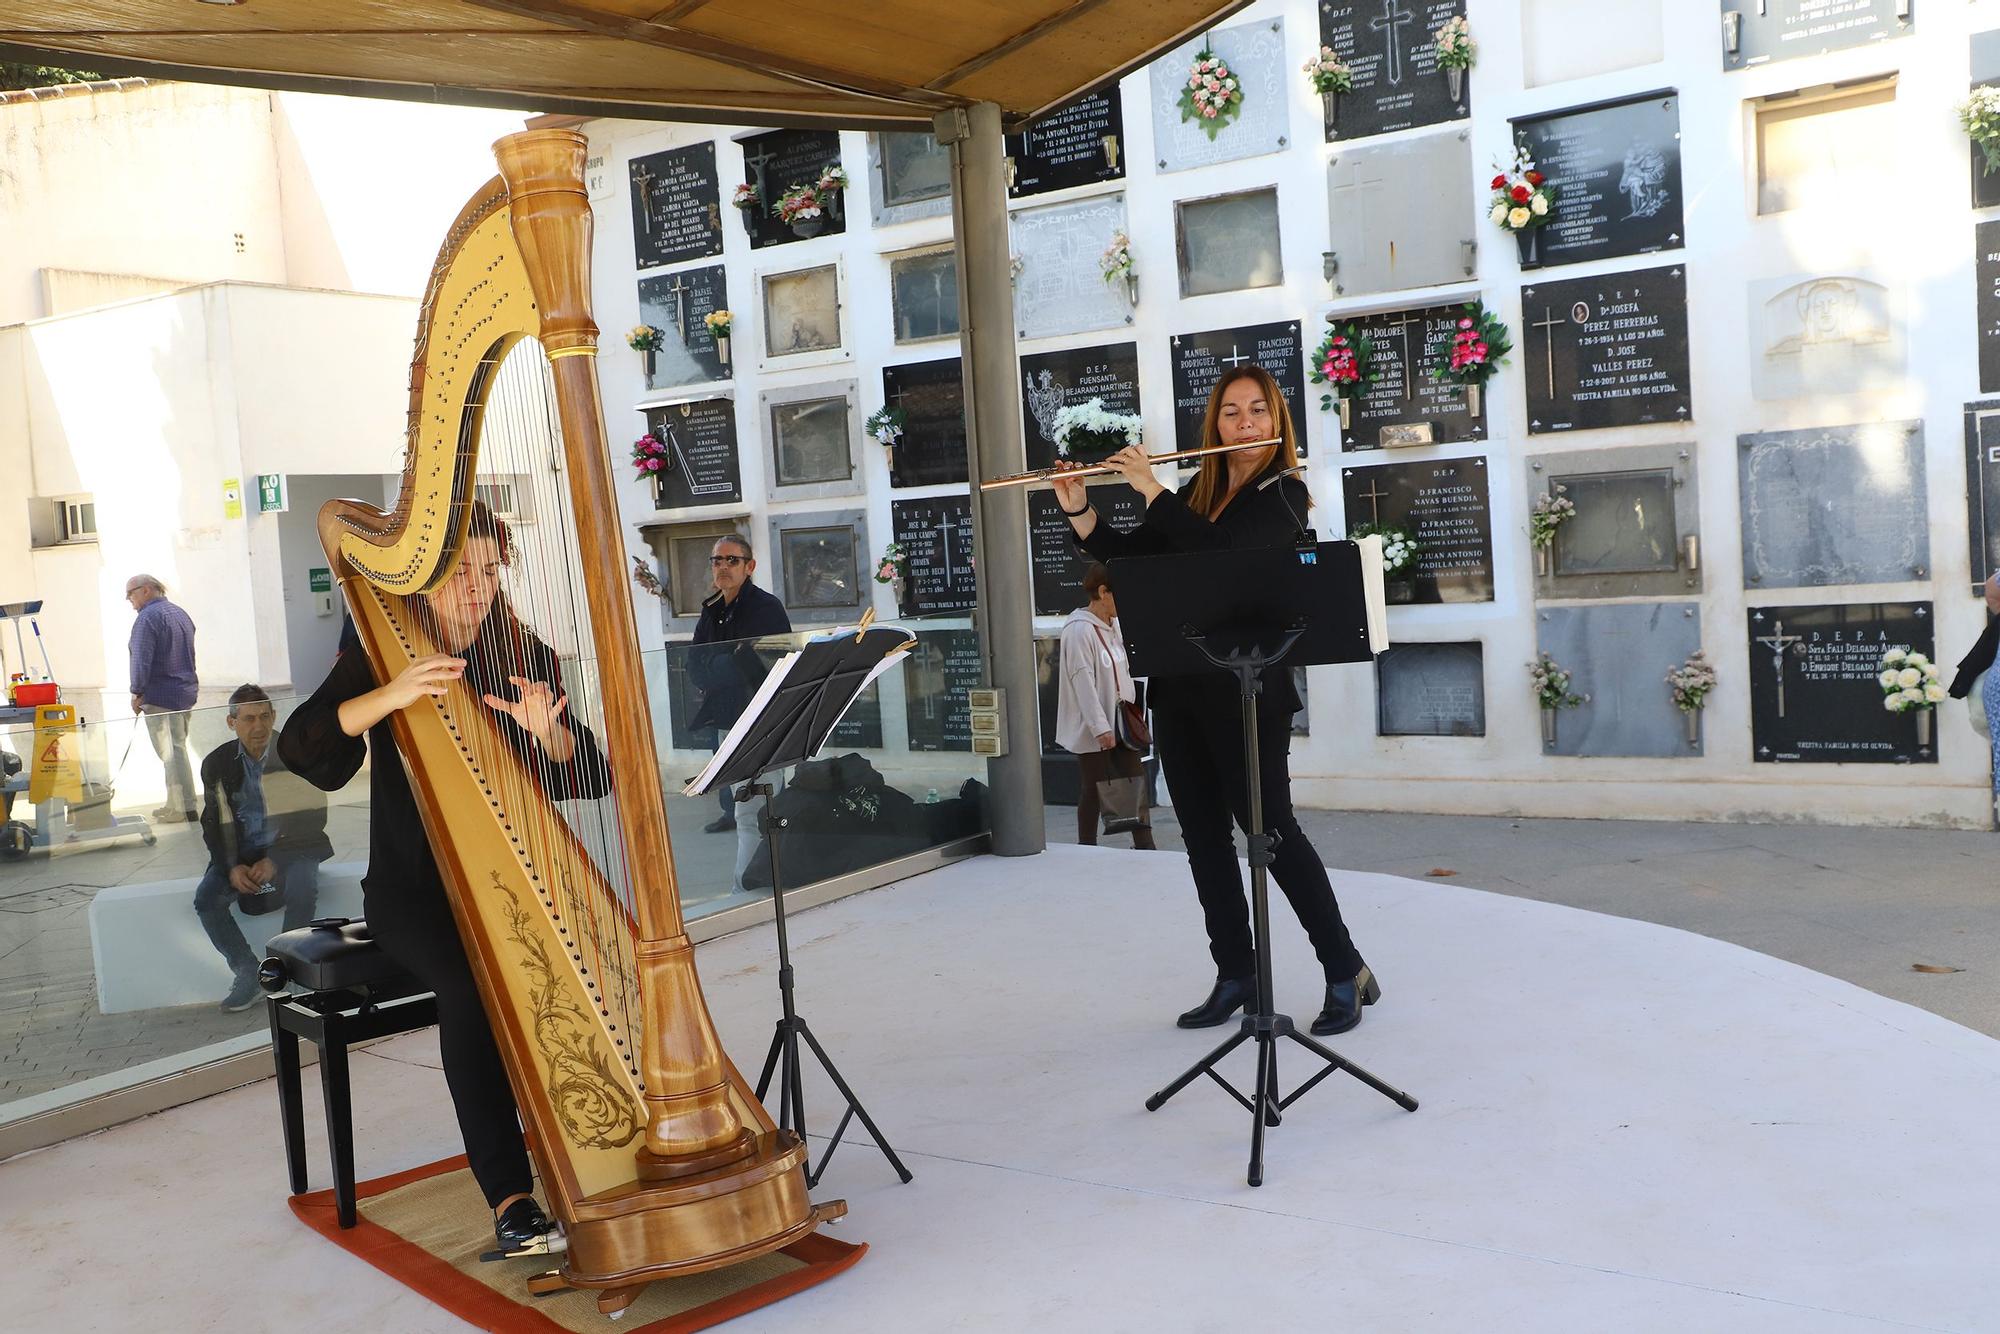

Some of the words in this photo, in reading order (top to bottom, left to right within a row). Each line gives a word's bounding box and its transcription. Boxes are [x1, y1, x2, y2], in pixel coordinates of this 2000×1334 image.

[1436, 2, 1456, 12] EMILIA
[1432, 11, 1452, 20] BAENA
[1335, 33, 1354, 41] BAENA
[1418, 60, 1434, 68] BAENA
[1070, 124, 1087, 134] PEREZ
[1089, 119, 1109, 130] RIVERA
[1575, 171, 1608, 181] CARRETERO
[674, 192, 691, 201] RAFAEL
[662, 203, 681, 213] ZAMORA
[1559, 204, 1592, 214] CARRETERO
[662, 230, 680, 239] ZAMORA
[1560, 227, 1593, 236] CARRETERO
[1610, 303, 1639, 314] JOSEFA
[1437, 320, 1456, 330] JUAN
[1584, 321, 1609, 332] PEREZ
[1614, 315, 1658, 329] HERRERIAS
[1374, 327, 1405, 337] DOLORES
[1258, 338, 1293, 349] FRANCISCO
[1184, 348, 1210, 358] MANUEL
[1259, 348, 1294, 359] RODRIGUEZ
[1617, 345, 1636, 355] JOSE
[1181, 357, 1215, 369] RODRIGUEZ
[1592, 362, 1623, 373] VALLES
[1627, 358, 1653, 369] PEREZ
[1187, 366, 1221, 377] SALMORAL
[1387, 370, 1401, 379] AÑOS
[1080, 374, 1117, 384] FUENSANTA
[1065, 386, 1099, 396] BEJARANO
[1101, 382, 1133, 392] MARTINEZ
[1419, 387, 1436, 396] HIJOS
[1375, 390, 1403, 399] POLITICOS
[1572, 392, 1601, 401] VUESTRA
[1603, 390, 1630, 398] FAMILIA
[1442, 495, 1477, 504] BUENDIA
[263, 502, 280, 510] ASEOS
[1418, 529, 1451, 538] PADILLA
[1447, 550, 1482, 558] ANTONIO
[1420, 561, 1452, 569] PADILLA
[1846, 644, 1879, 653] DELGADO
[1810, 662, 1839, 672] ENRIQUE
[1842, 662, 1874, 671] DELGADO
